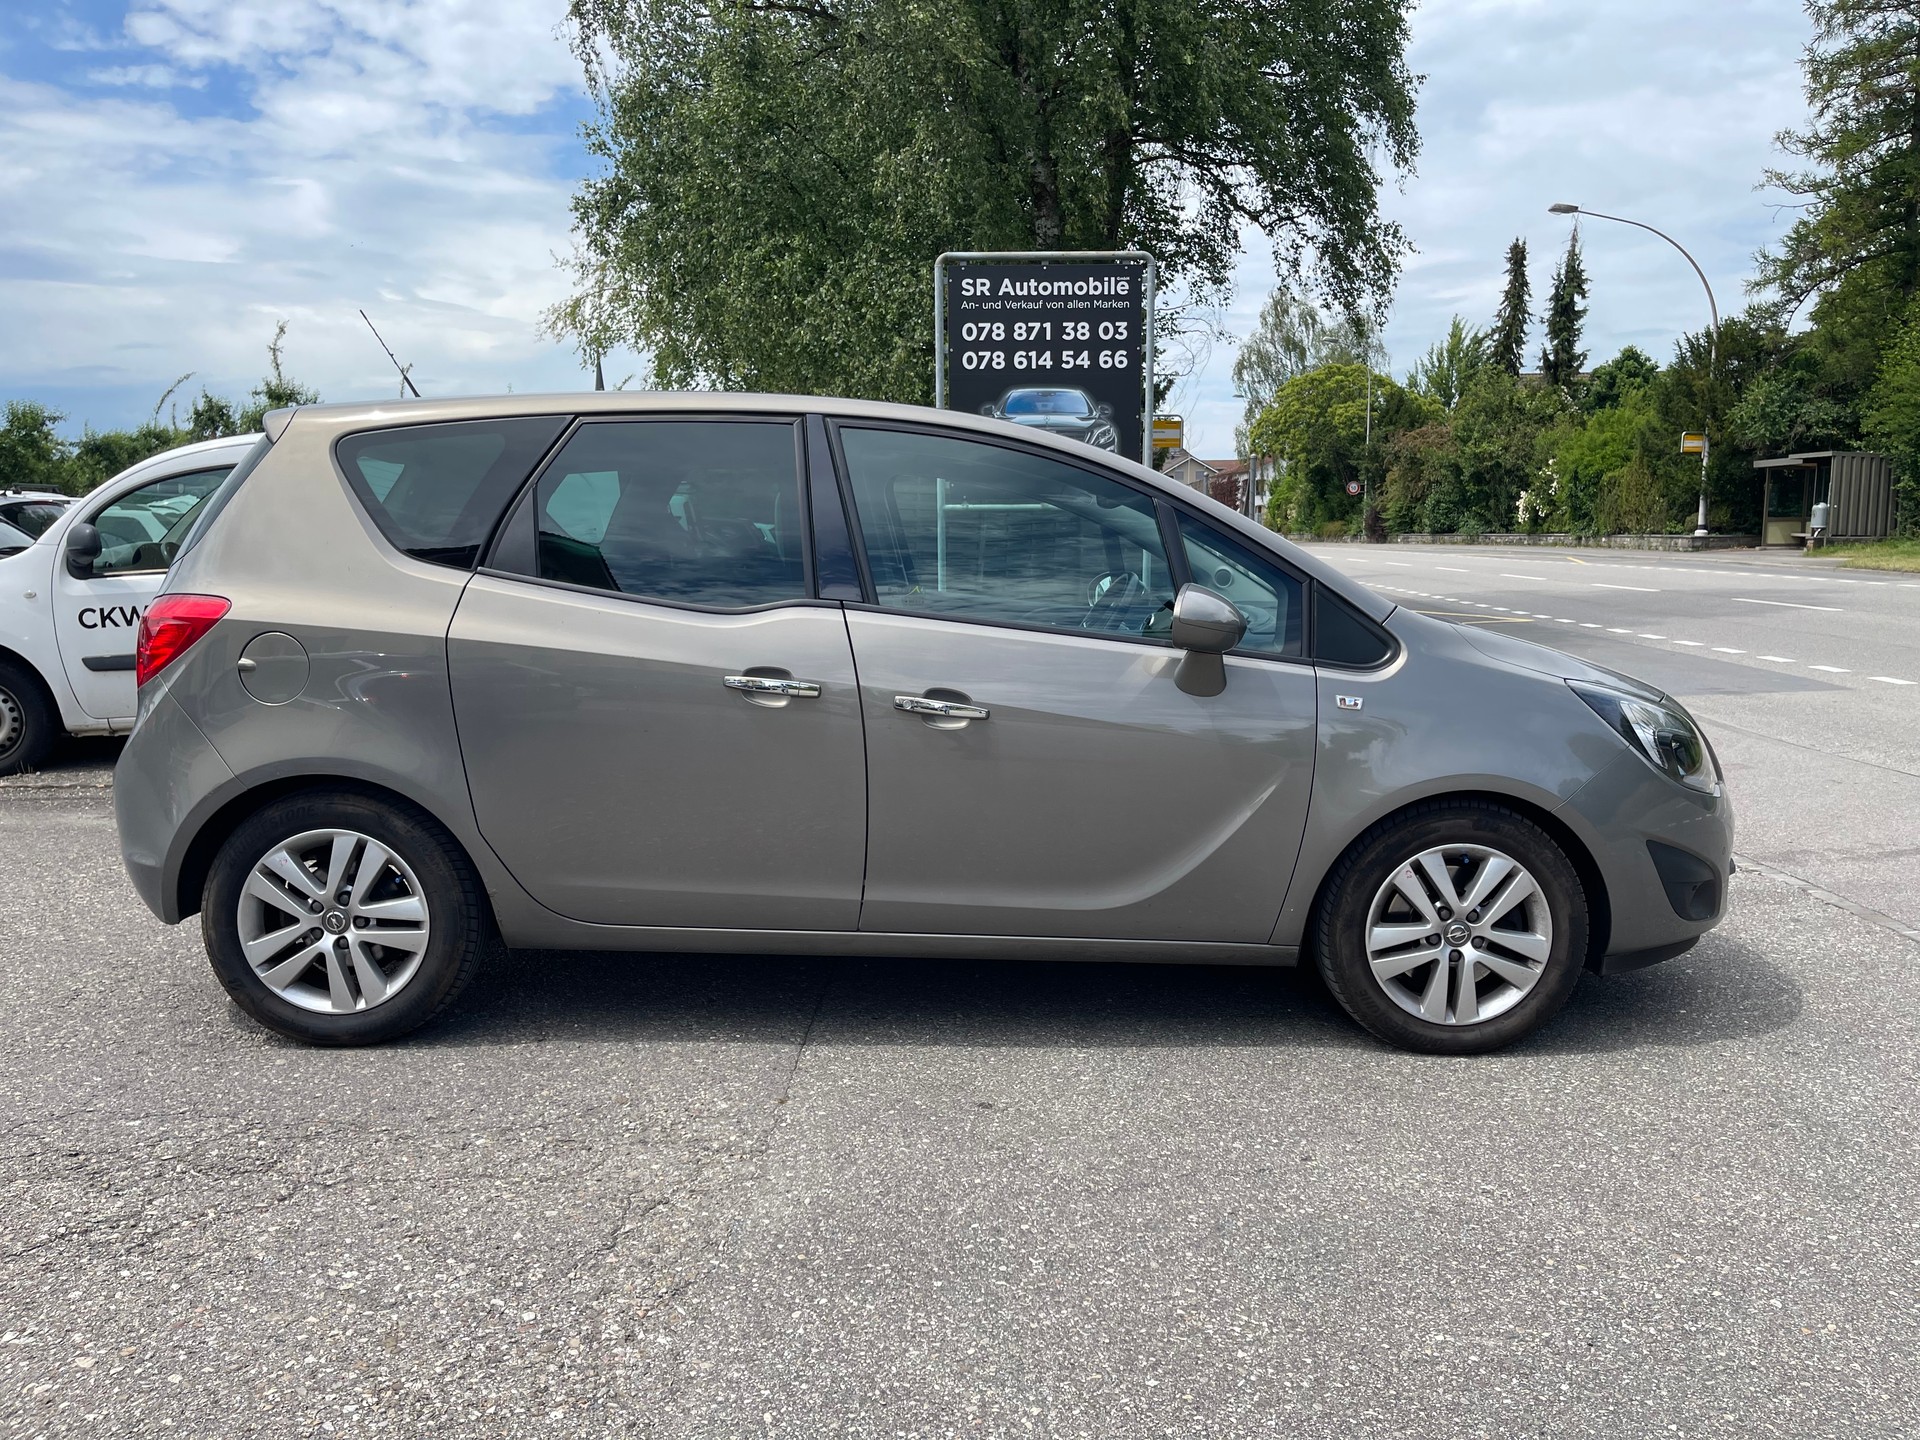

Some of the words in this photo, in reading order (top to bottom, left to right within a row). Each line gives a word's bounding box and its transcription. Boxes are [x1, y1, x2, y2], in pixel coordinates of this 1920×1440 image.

[961, 278, 991, 296] SR
[998, 276, 1130, 296] Automobile
[961, 300, 980, 310] An-
[982, 300, 1002, 310] und
[1005, 299, 1043, 310] Verkauf
[1045, 301, 1064, 309] von
[1067, 299, 1091, 309] allen
[1094, 299, 1130, 309] Marken
[961, 322, 1006, 341] 078
[1013, 322, 1052, 341] 871
[1061, 321, 1091, 341] 38
[1098, 321, 1128, 341] 03
[961, 351, 1006, 370] 078
[1013, 350, 1053, 370] 614
[1061, 350, 1091, 369] 54
[1099, 350, 1128, 369] 66
[77, 605, 149, 629] CKW
